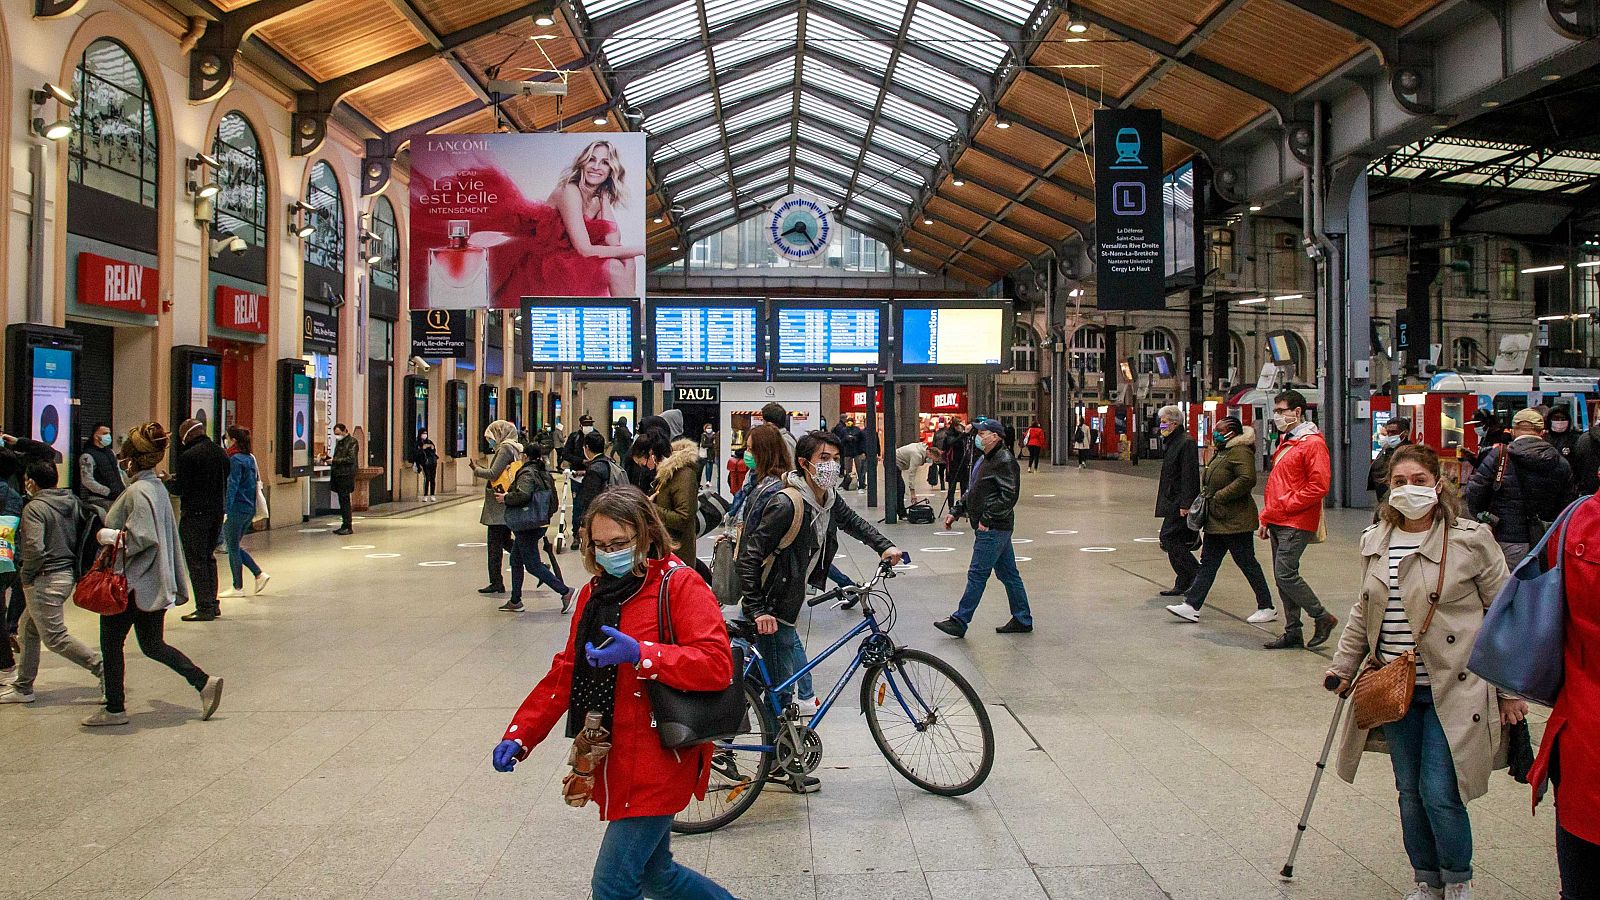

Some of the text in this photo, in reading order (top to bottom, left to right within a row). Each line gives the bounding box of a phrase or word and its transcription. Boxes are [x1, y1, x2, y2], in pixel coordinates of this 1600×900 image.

[428, 139, 490, 151] LANCÔME
[434, 178, 484, 191] La vie
[420, 191, 498, 204] est belle
[1123, 190, 1135, 207] L
[429, 206, 488, 214] INTENSÉMENT
[105, 264, 143, 302] RELAY
[235, 294, 259, 325] RELAY
[928, 309, 938, 364] Information
[1401, 330, 1407, 344] 6
[679, 388, 714, 400] PAUL
[934, 393, 957, 408] RELAY
